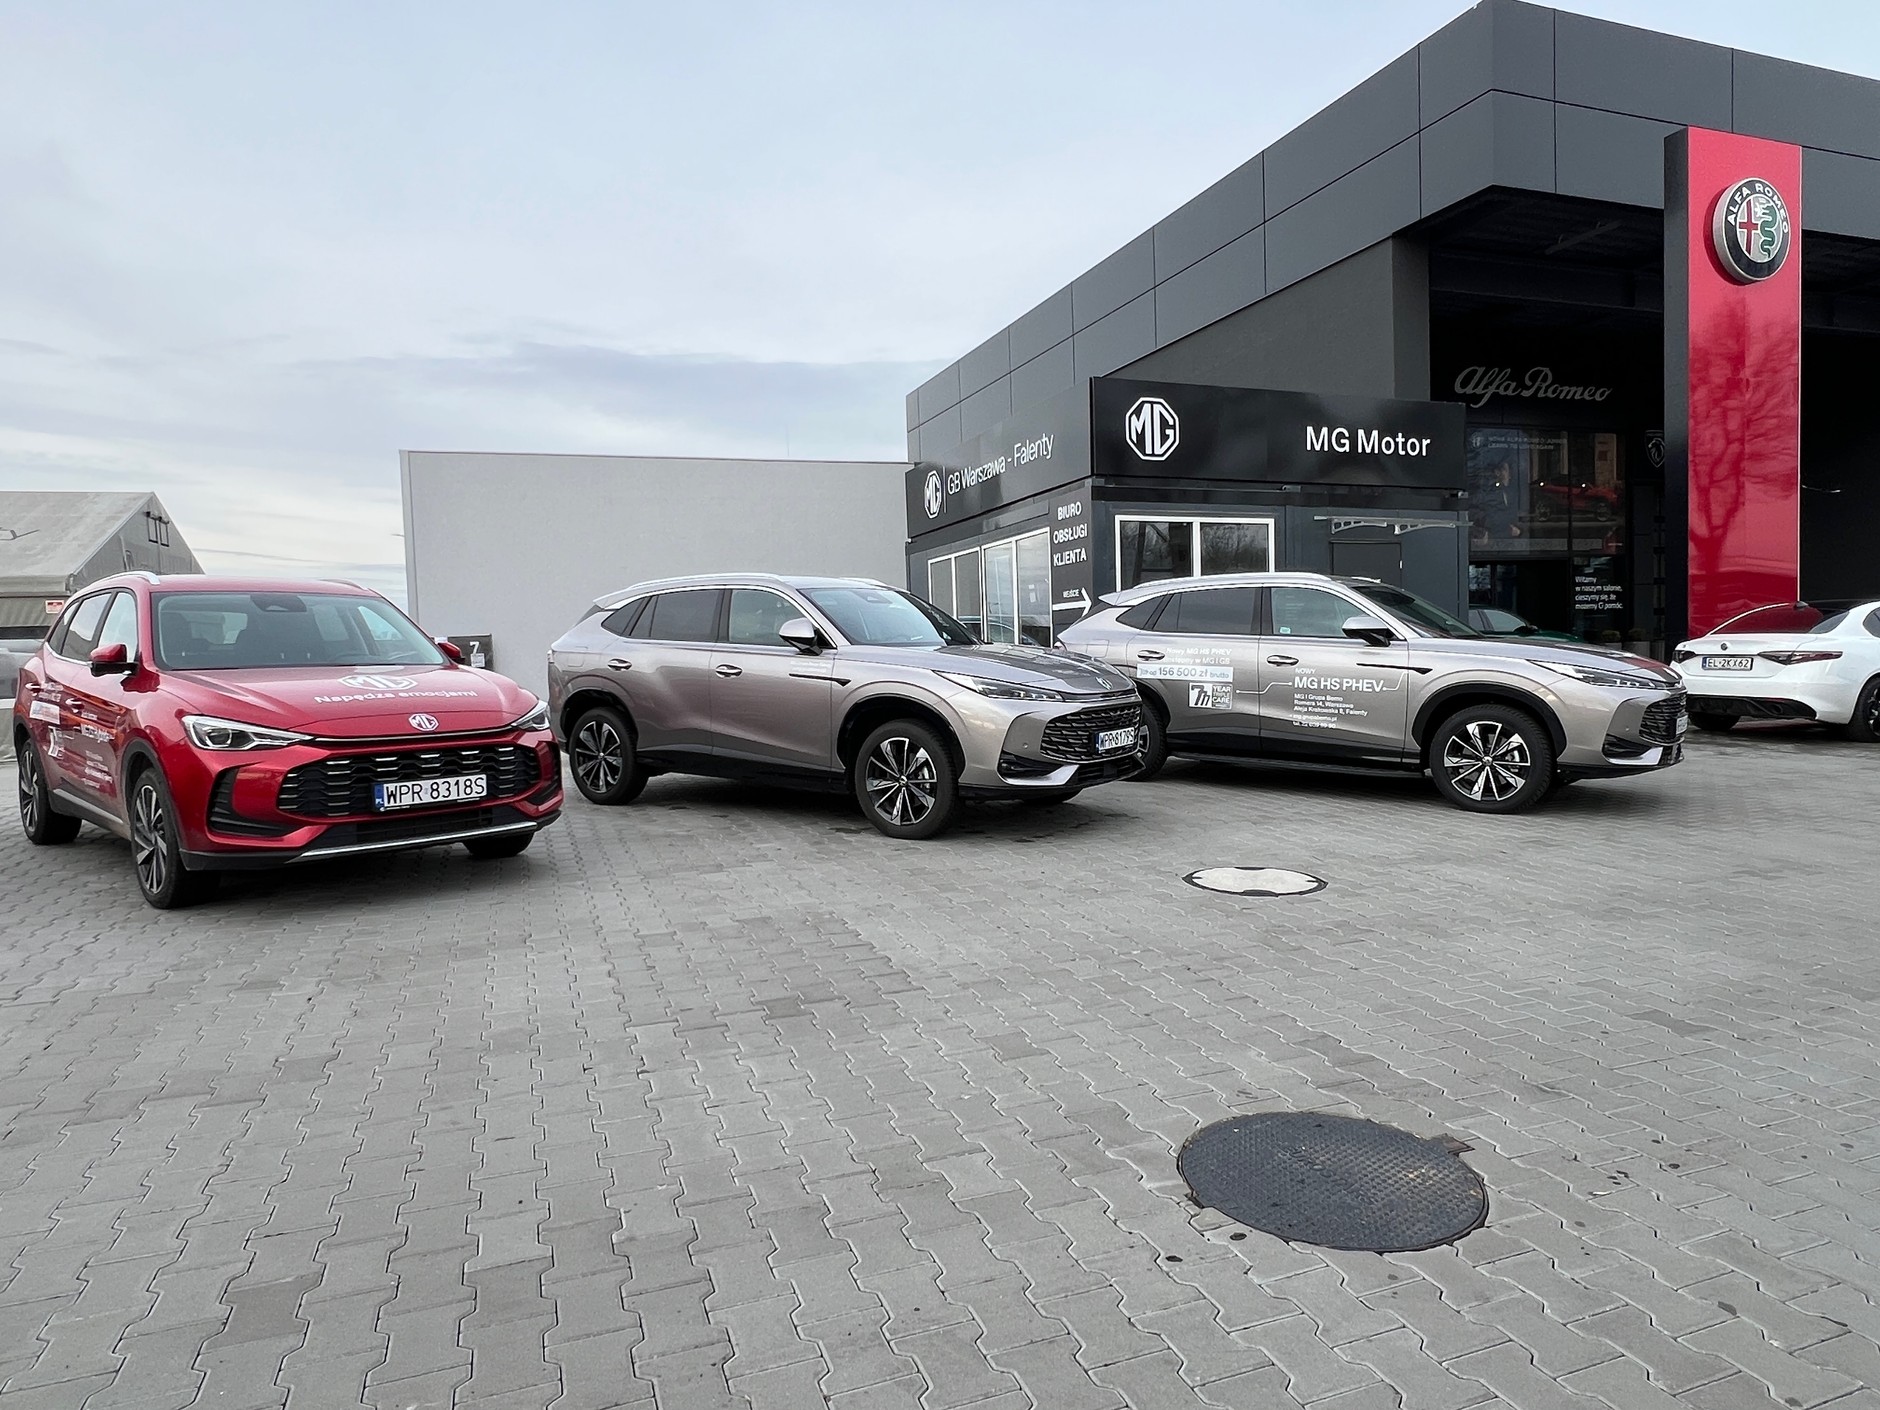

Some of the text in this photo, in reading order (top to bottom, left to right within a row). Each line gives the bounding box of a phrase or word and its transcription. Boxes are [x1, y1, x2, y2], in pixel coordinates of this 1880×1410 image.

[1727, 183, 1789, 233] ALFA ROMEO
[1454, 366, 1613, 408] Alfa Romeo
[1128, 400, 1177, 458] MG
[1306, 426, 1431, 457] MG Motor
[947, 474, 961, 495] GB
[961, 457, 1006, 489] Warszawa
[1014, 432, 1054, 467] Falenty
[926, 473, 941, 516] MG
[1057, 501, 1082, 521] BIURO
[1053, 523, 1088, 544] OBSŁUGI
[1053, 547, 1087, 567] KLIENTA
[469, 641, 480, 655] 7
[1211, 648, 1232, 656] PHEV
[1159, 667, 1175, 676] 156
[1176, 667, 1197, 677] 500
[1199, 668, 1208, 678] zł
[1209, 671, 1230, 679] brutto
[1708, 659, 1749, 668] EL 2KX62
[347, 675, 410, 690] MG
[1294, 677, 1384, 692] MG HS PHEV
[314, 690, 478, 703] Napędza emocjami
[410, 714, 438, 731] MG
[1345, 709, 1368, 717] Falenty
[1100, 729, 1134, 748] WPR 8179S
[386, 777, 485, 804] WPR 8318S
